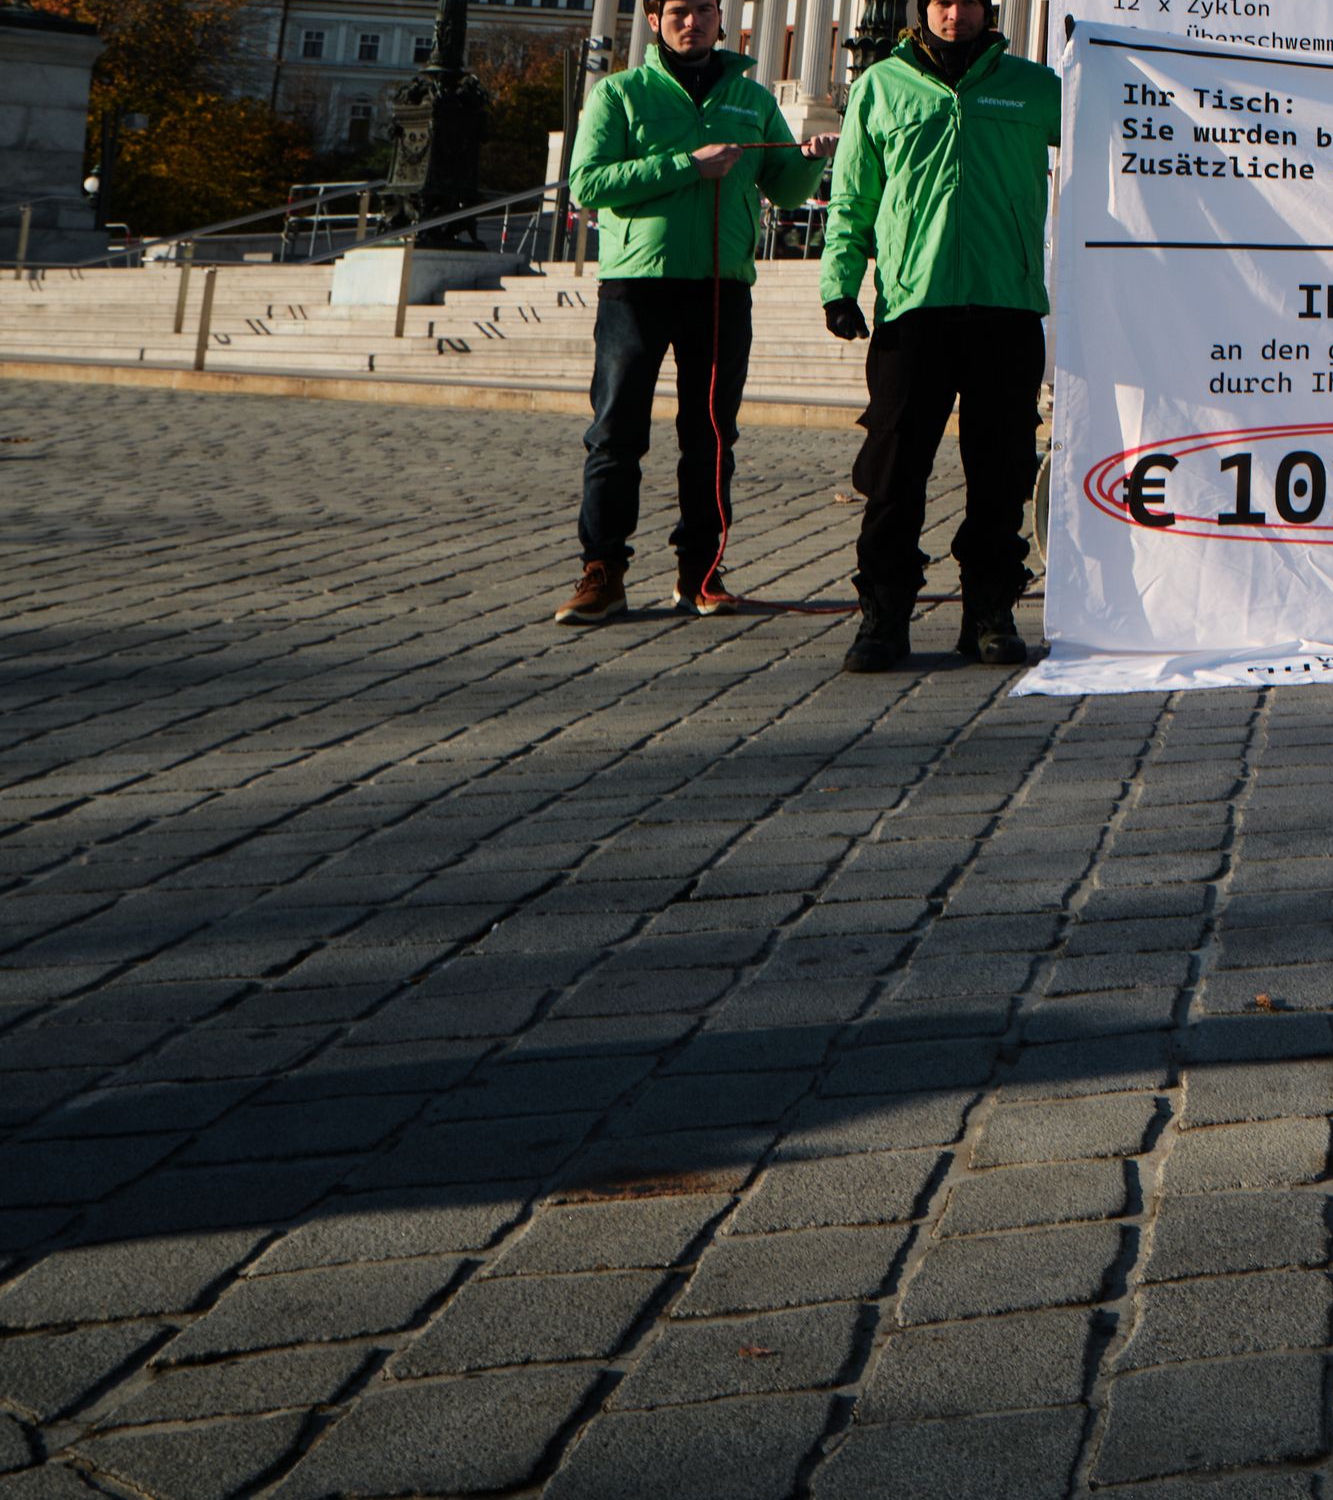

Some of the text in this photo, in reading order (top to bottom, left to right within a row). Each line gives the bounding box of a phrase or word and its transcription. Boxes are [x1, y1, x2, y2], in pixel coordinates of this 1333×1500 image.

[1158, 0, 1170, 12] x
[1124, 83, 1293, 114] Ihr Tisch:
[1122, 117, 1174, 141] Sie
[1193, 122, 1297, 146] wurden
[1121, 152, 1314, 180] Zusätzliche
[1211, 344, 1241, 360] an
[1262, 339, 1309, 360] den
[1210, 372, 1291, 393] durch
[1123, 453, 1176, 527] €
